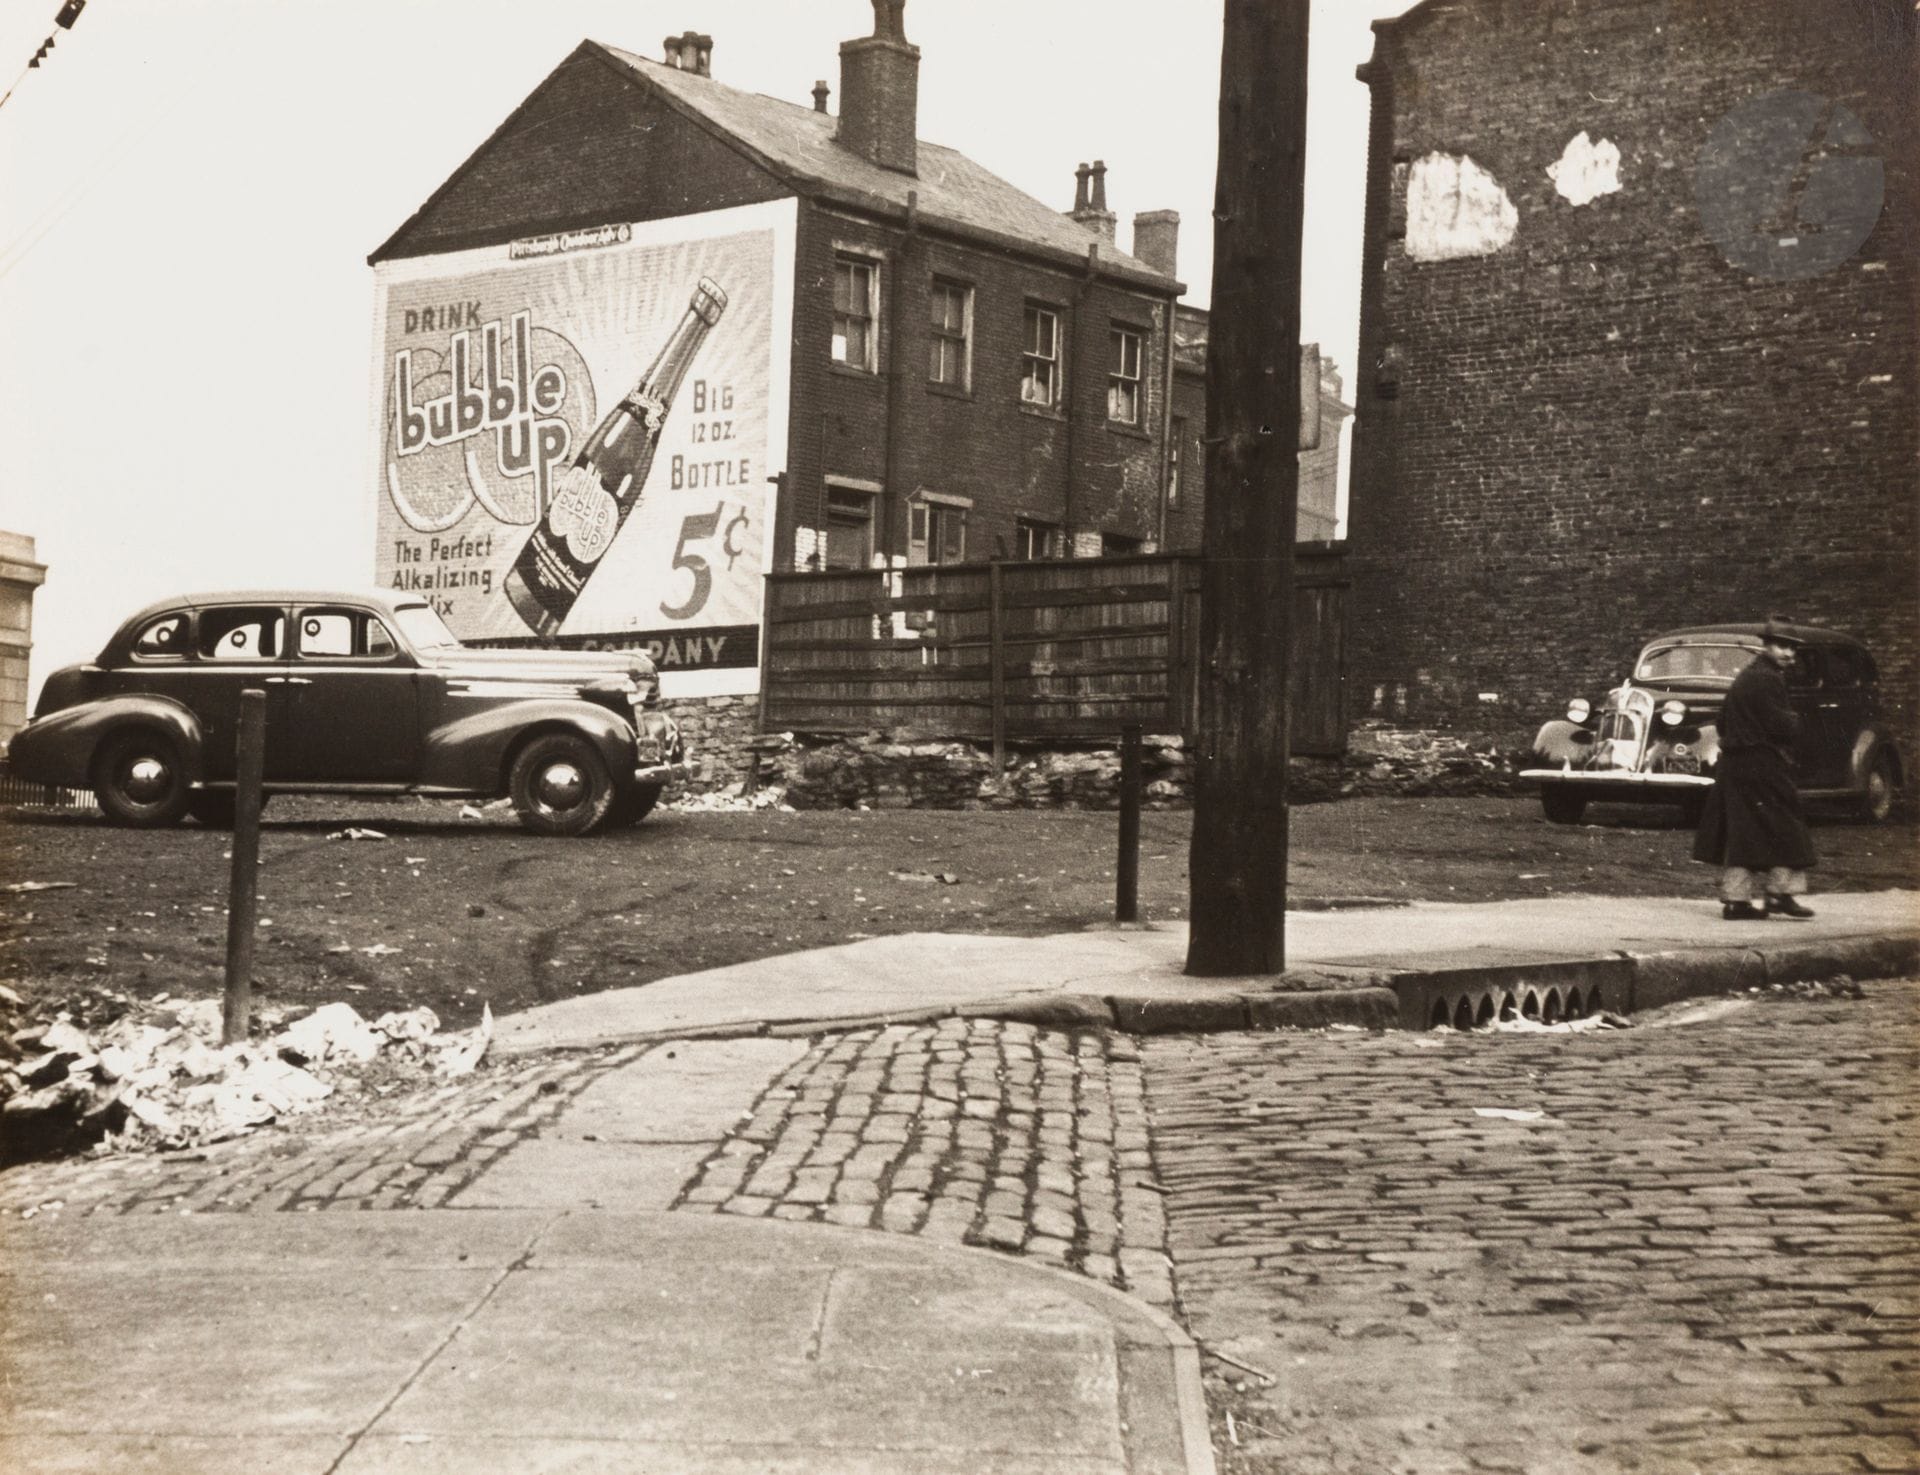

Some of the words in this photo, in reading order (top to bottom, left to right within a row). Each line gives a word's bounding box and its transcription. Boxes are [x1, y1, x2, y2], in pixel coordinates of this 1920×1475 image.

[405, 301, 481, 334] DRINK
[692, 422, 706, 443] 12
[395, 540, 421, 563] The
[430, 534, 492, 561] Perfect
[392, 564, 492, 594] Alkalizing
[424, 594, 454, 616] ix
